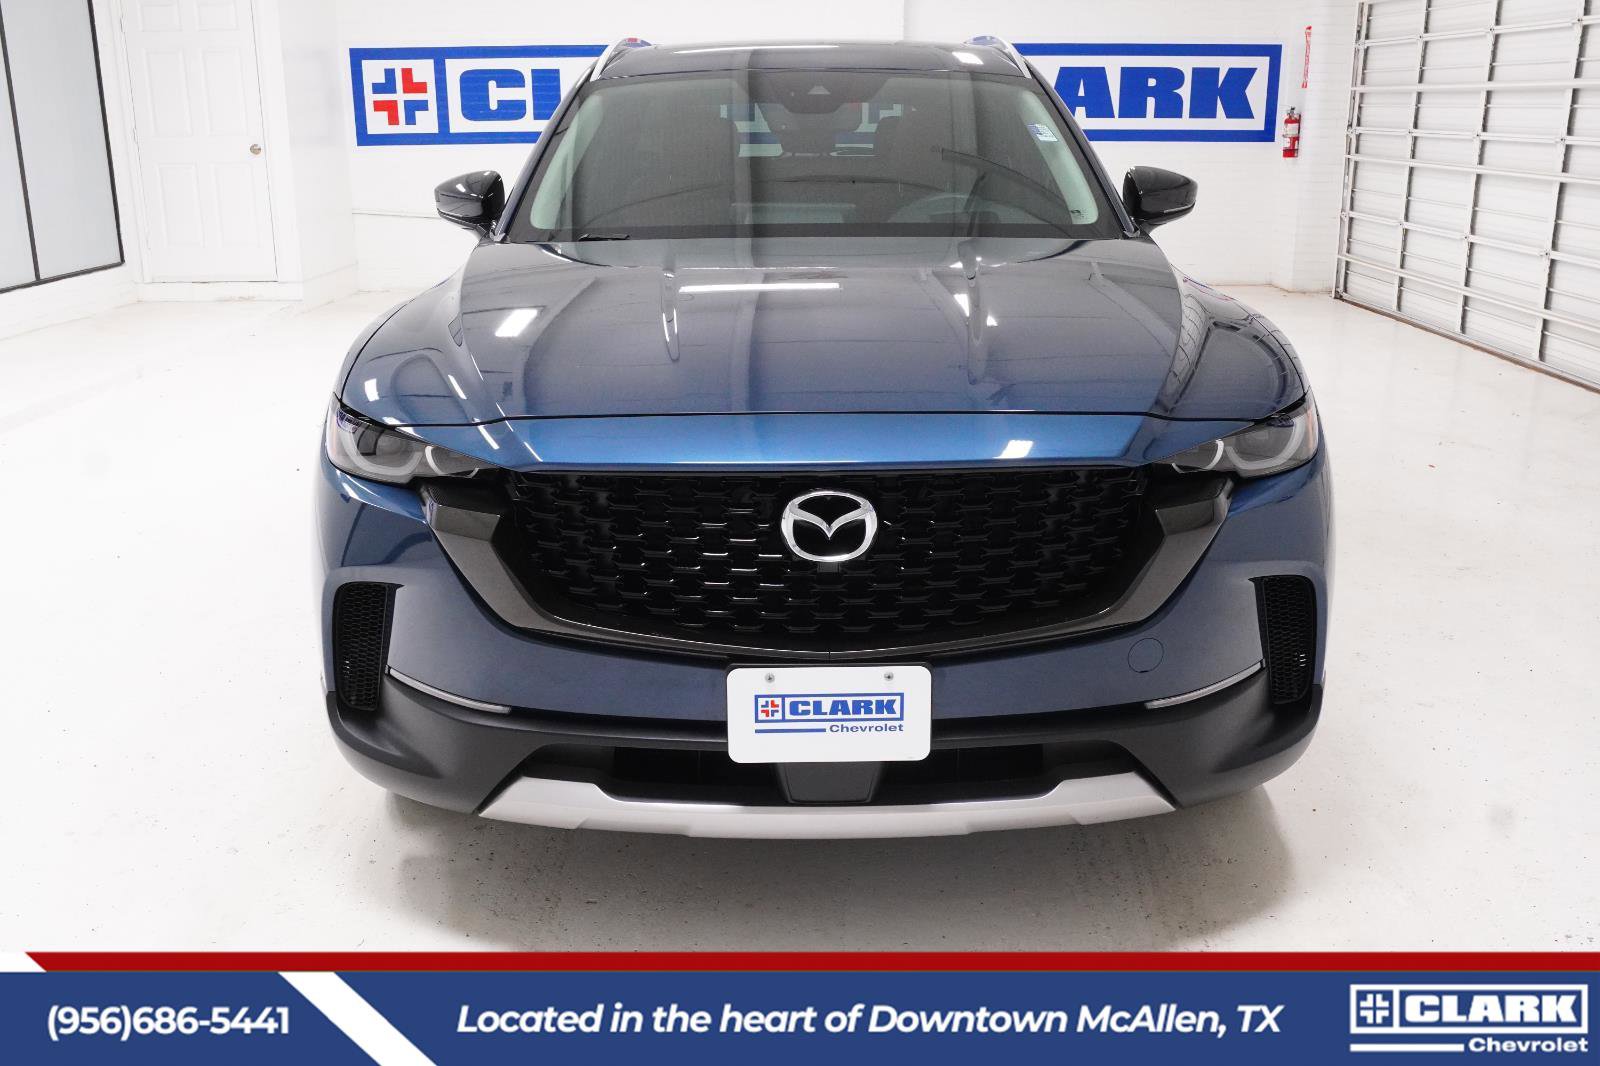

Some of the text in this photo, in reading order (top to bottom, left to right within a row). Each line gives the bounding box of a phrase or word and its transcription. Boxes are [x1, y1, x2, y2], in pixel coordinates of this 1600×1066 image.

[1053, 66, 1258, 120] ARK
[788, 699, 897, 716] CLARK
[829, 723, 904, 733] Chevrolet
